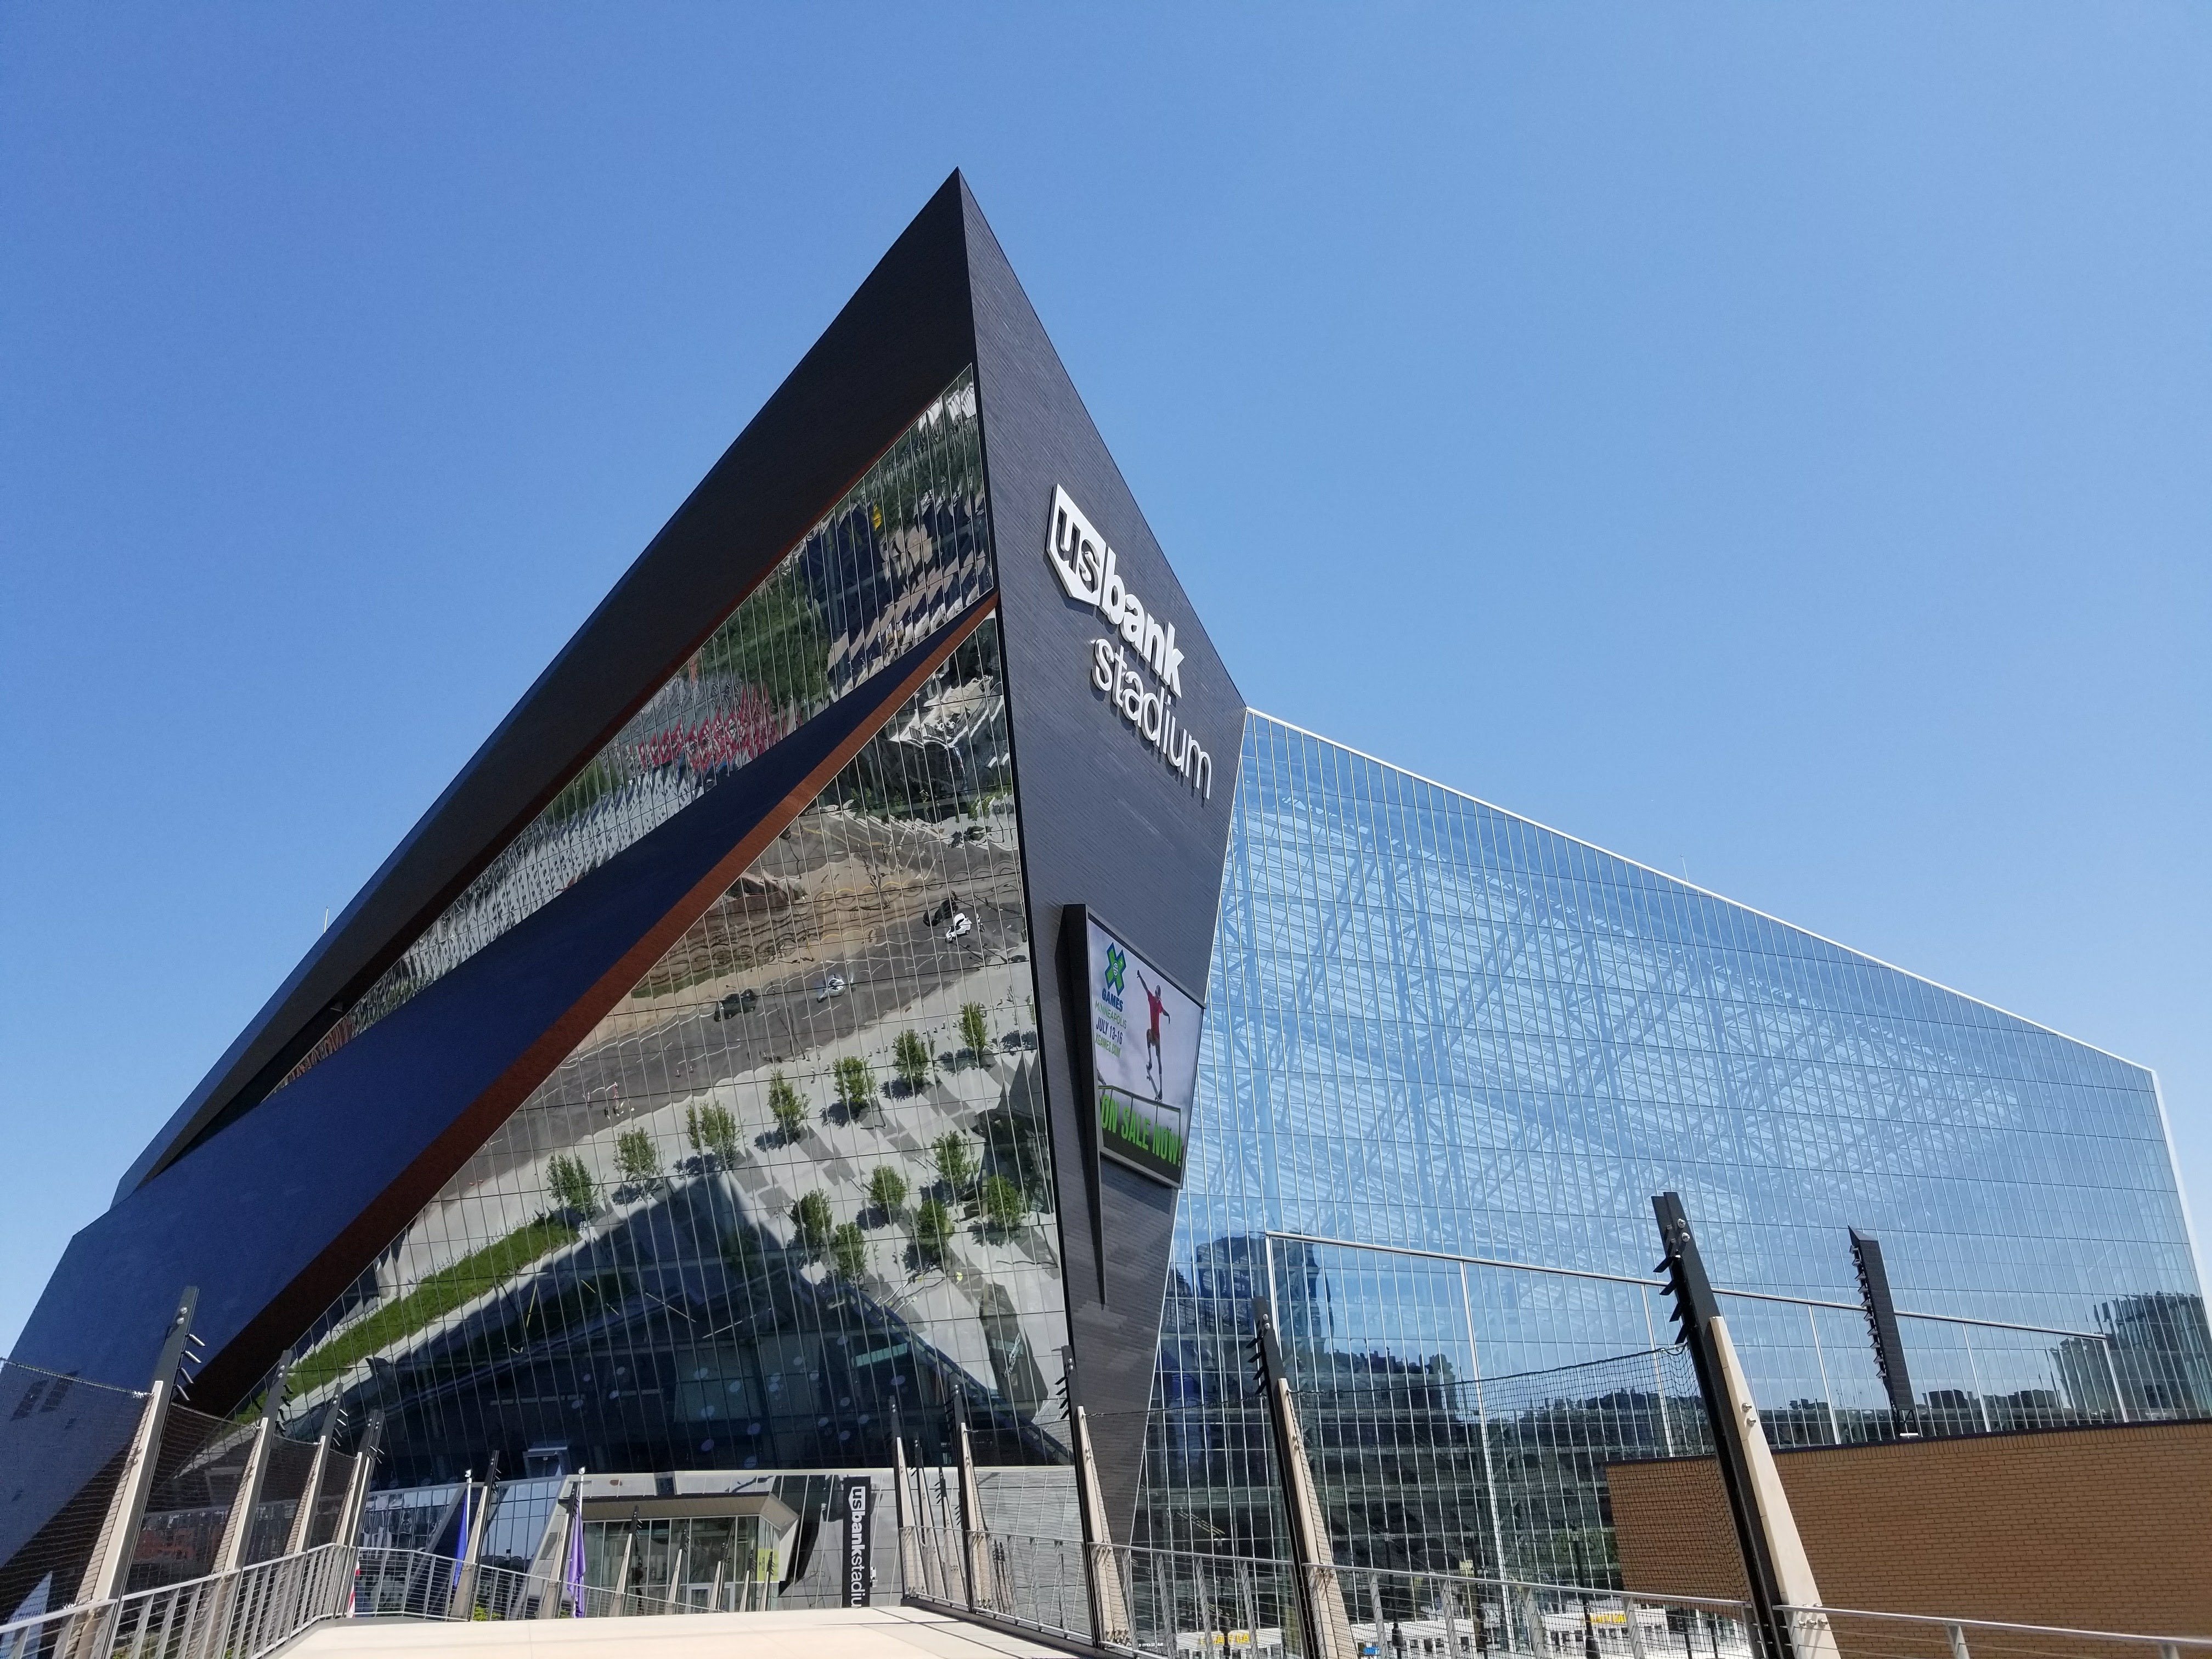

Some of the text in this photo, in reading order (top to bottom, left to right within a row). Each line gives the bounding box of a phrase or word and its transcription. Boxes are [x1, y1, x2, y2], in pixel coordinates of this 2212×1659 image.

[1092, 639, 1211, 800] stadium
[1095, 1000, 1127, 1029] MINNEAPOLIS
[1102, 988, 1124, 1012] GAMES
[1096, 1016, 1123, 1045] JULY 13-16
[1101, 1094, 1182, 1167] ON SALE NOW!
